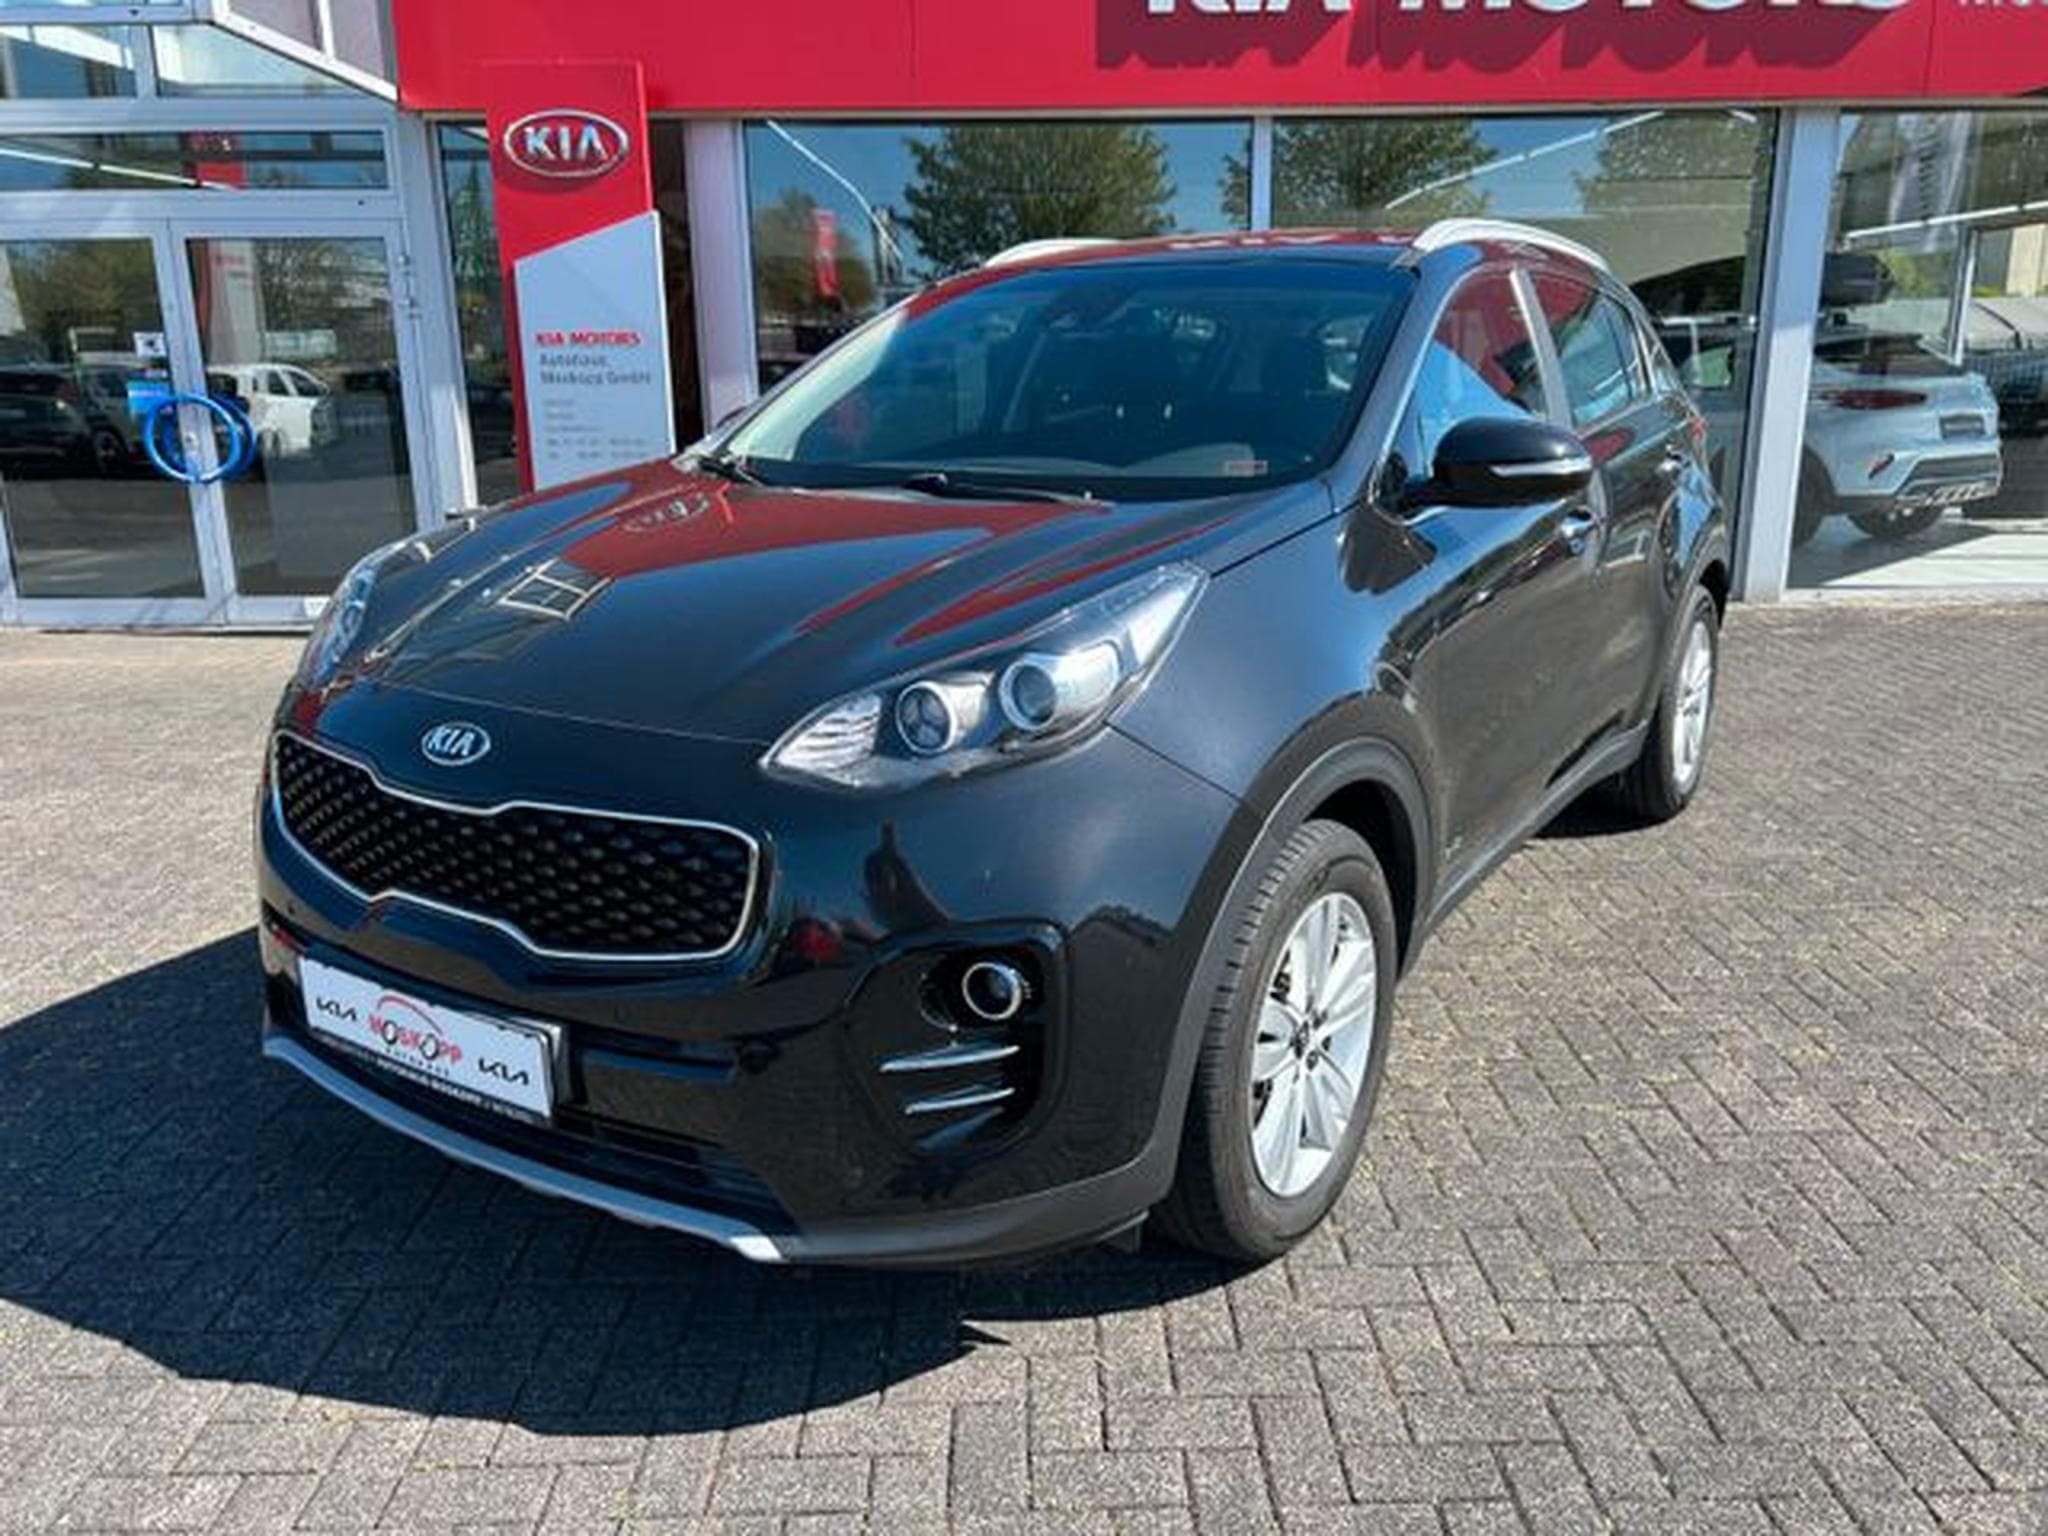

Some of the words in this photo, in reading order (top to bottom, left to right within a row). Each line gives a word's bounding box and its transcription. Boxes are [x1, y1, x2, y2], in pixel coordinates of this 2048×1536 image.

[523, 124, 609, 160] KIA
[535, 331, 564, 347] KIA
[570, 331, 641, 347] MOTORS
[427, 727, 476, 756] KIA
[316, 997, 357, 1022] KIA
[478, 1057, 530, 1086] KIA
